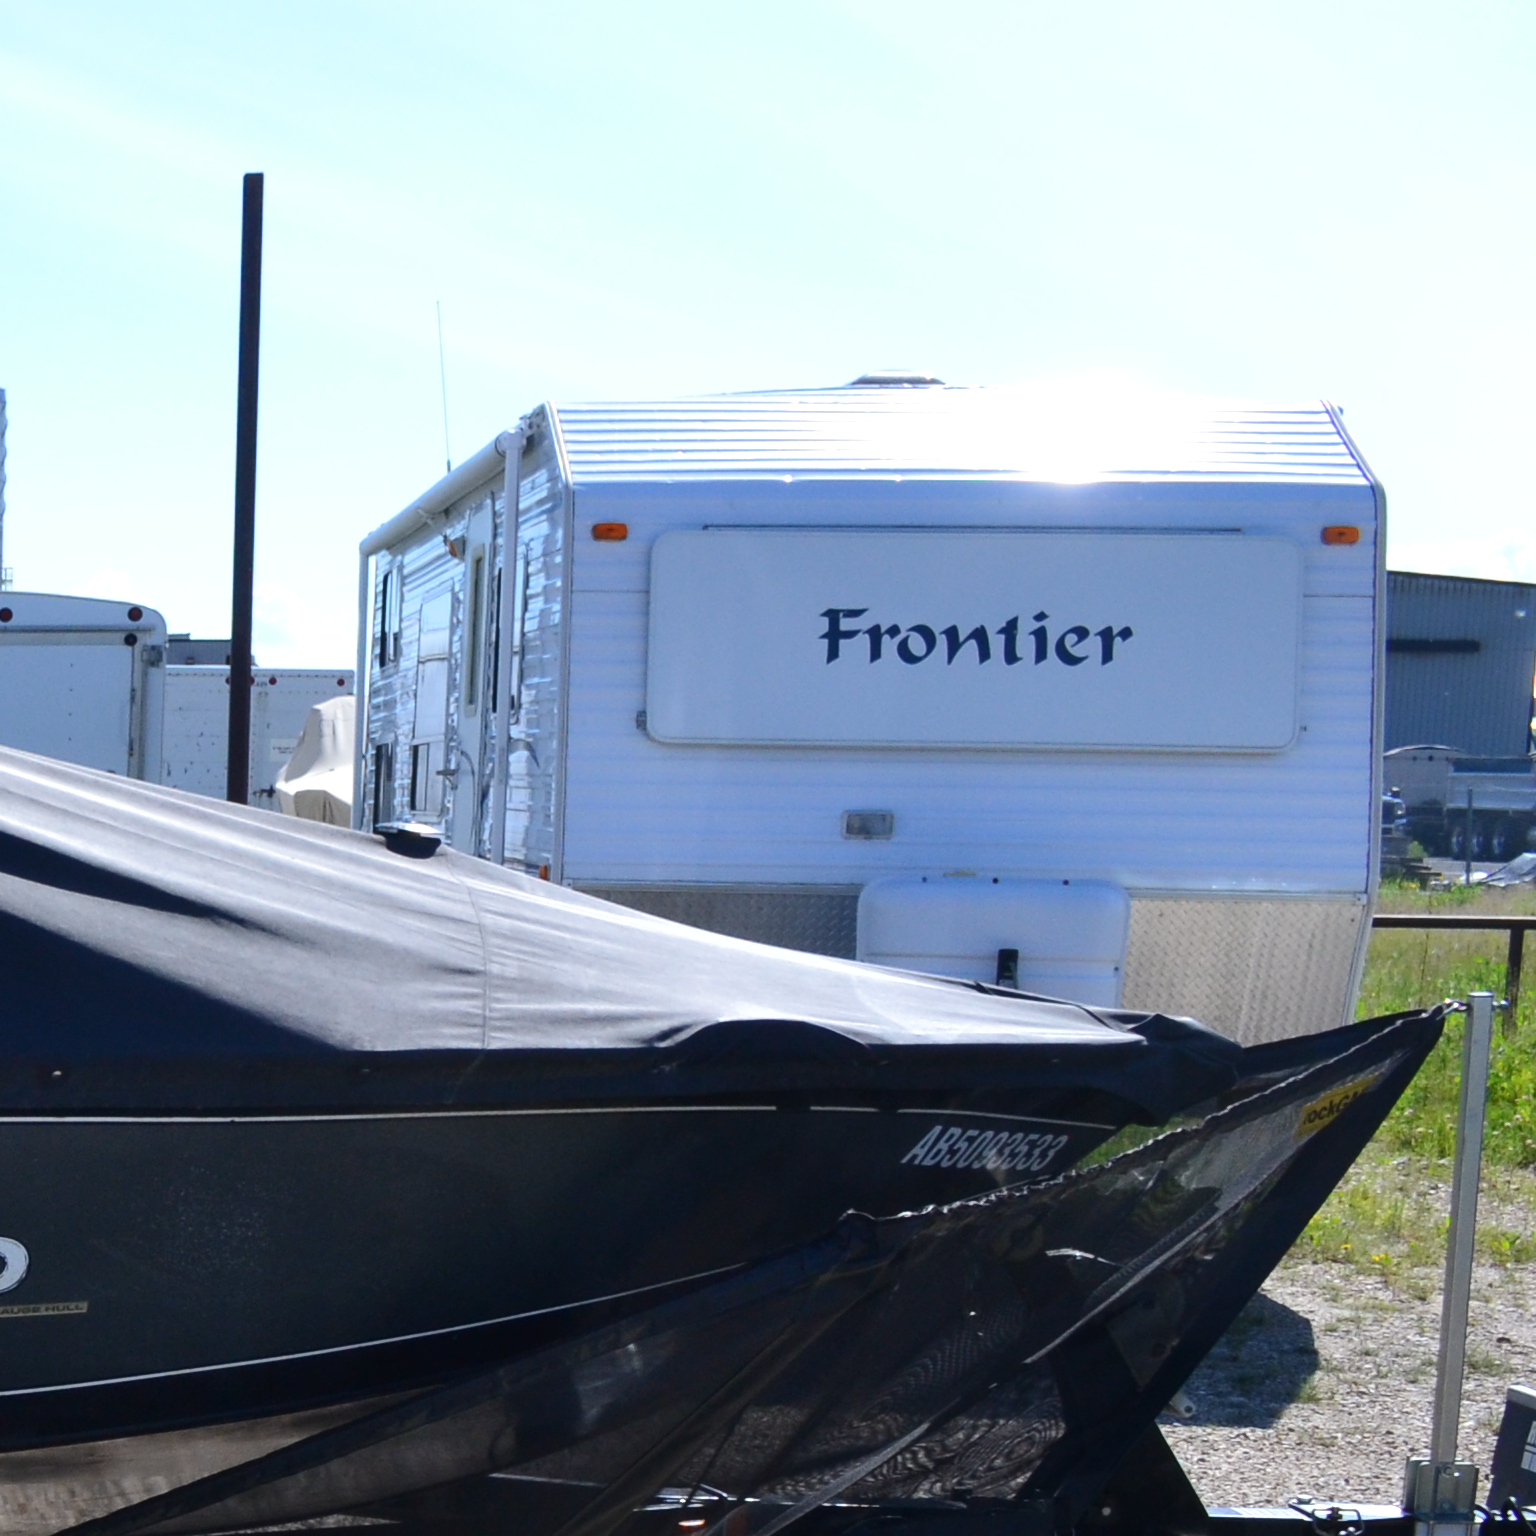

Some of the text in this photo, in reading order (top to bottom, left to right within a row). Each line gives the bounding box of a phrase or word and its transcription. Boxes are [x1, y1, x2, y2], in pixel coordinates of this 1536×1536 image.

[818, 607, 1134, 667] Frontier
[899, 1125, 1069, 1171] AB5093533
[45, 1303, 84, 1312] HULL
